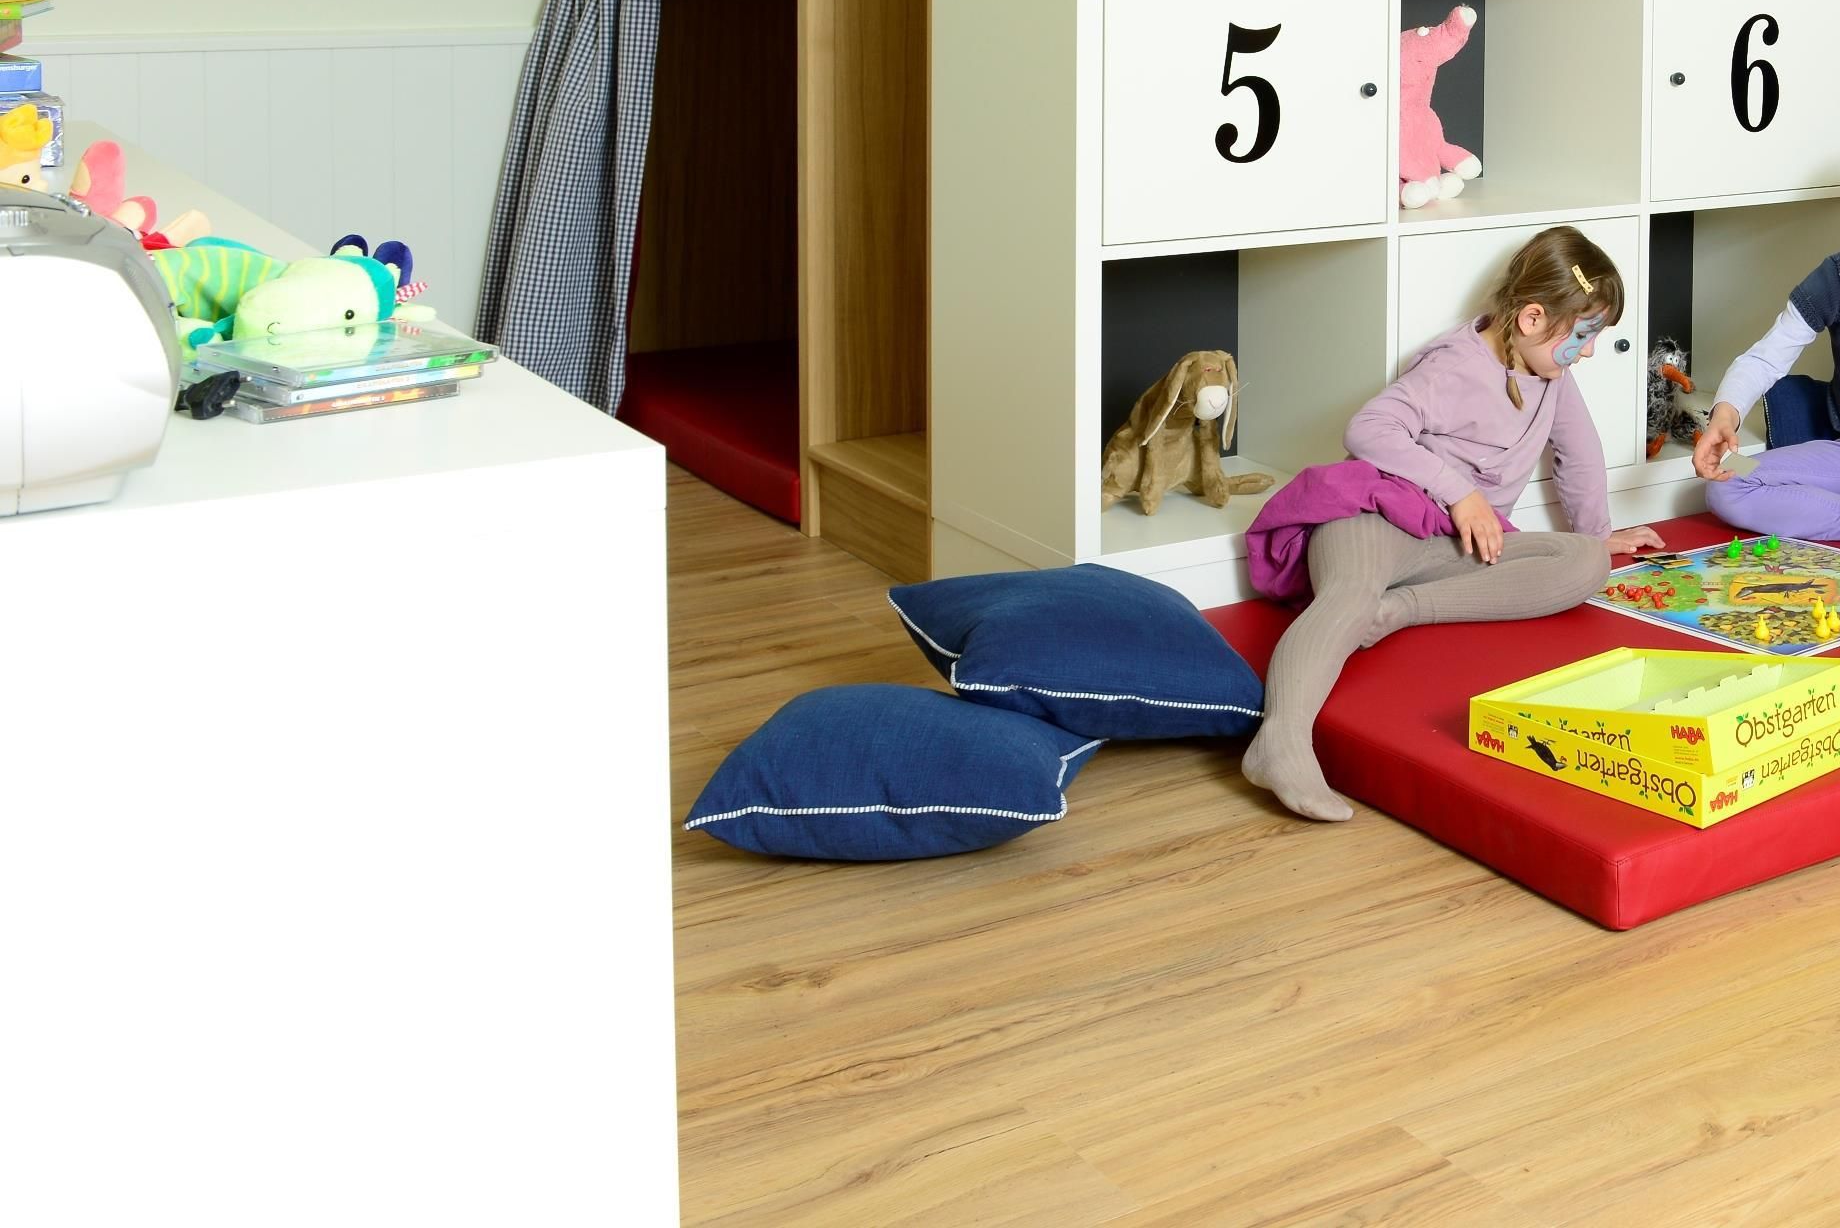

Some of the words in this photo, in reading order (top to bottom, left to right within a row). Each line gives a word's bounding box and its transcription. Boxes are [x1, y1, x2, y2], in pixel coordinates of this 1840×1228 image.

[1214, 22, 1282, 164] 5
[1730, 13, 1780, 133] 6
[1475, 730, 1504, 753] HABA
[1671, 725, 1705, 745] HABA
[1735, 692, 1837, 748] Obstgarten
[1576, 749, 1697, 808] Obstgarten
[1709, 789, 1739, 813] HABA
